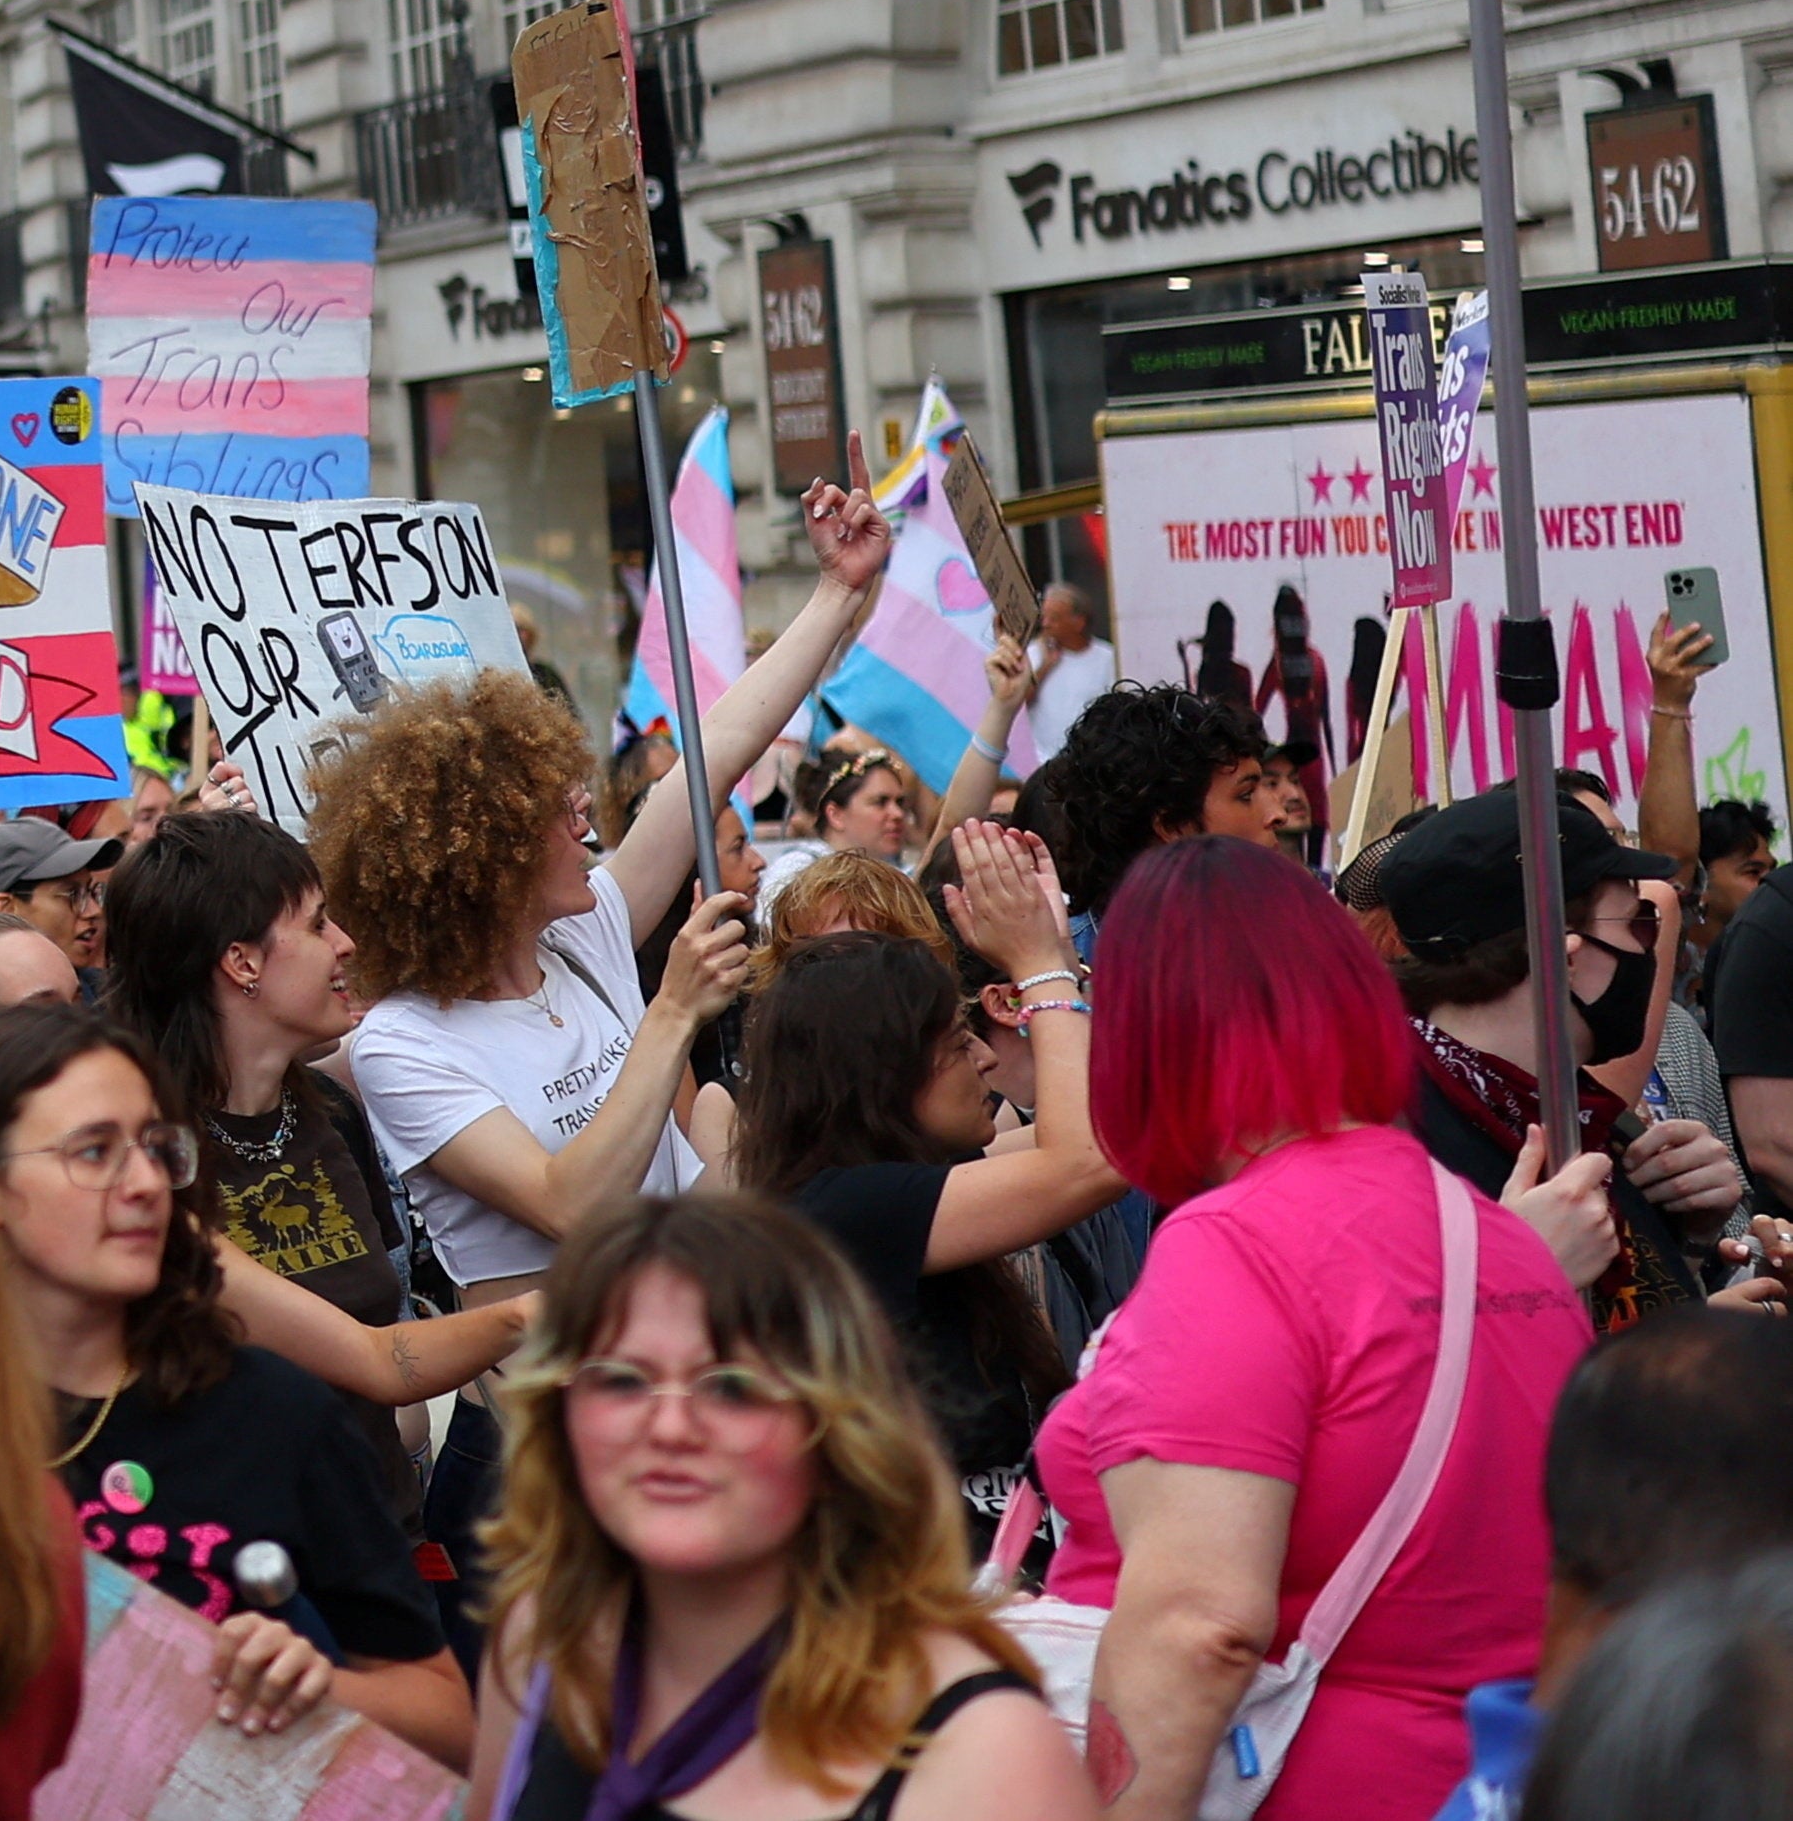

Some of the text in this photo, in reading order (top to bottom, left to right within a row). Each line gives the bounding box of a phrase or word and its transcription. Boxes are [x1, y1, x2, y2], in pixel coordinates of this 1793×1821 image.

[1071, 126, 1480, 242] Fanatics Collectible
[105, 201, 250, 273] Protect
[242, 280, 346, 341] Our
[110, 328, 295, 412] Trans
[1372, 313, 1426, 393] Trans
[106, 418, 340, 505] Siblings
[1384, 401, 1442, 498] Rights
[144, 501, 246, 622] NO
[231, 513, 441, 614] TERFS
[434, 515, 500, 599] ON
[1205, 520, 1271, 559] MOST
[1280, 517, 1326, 557] FUN
[1332, 515, 1368, 555] YOU
[1541, 506, 1616, 550] WEST
[201, 622, 320, 719] OUR
[542, 1062, 597, 1104] PRETTY
[276, 1235, 363, 1275] AINE
